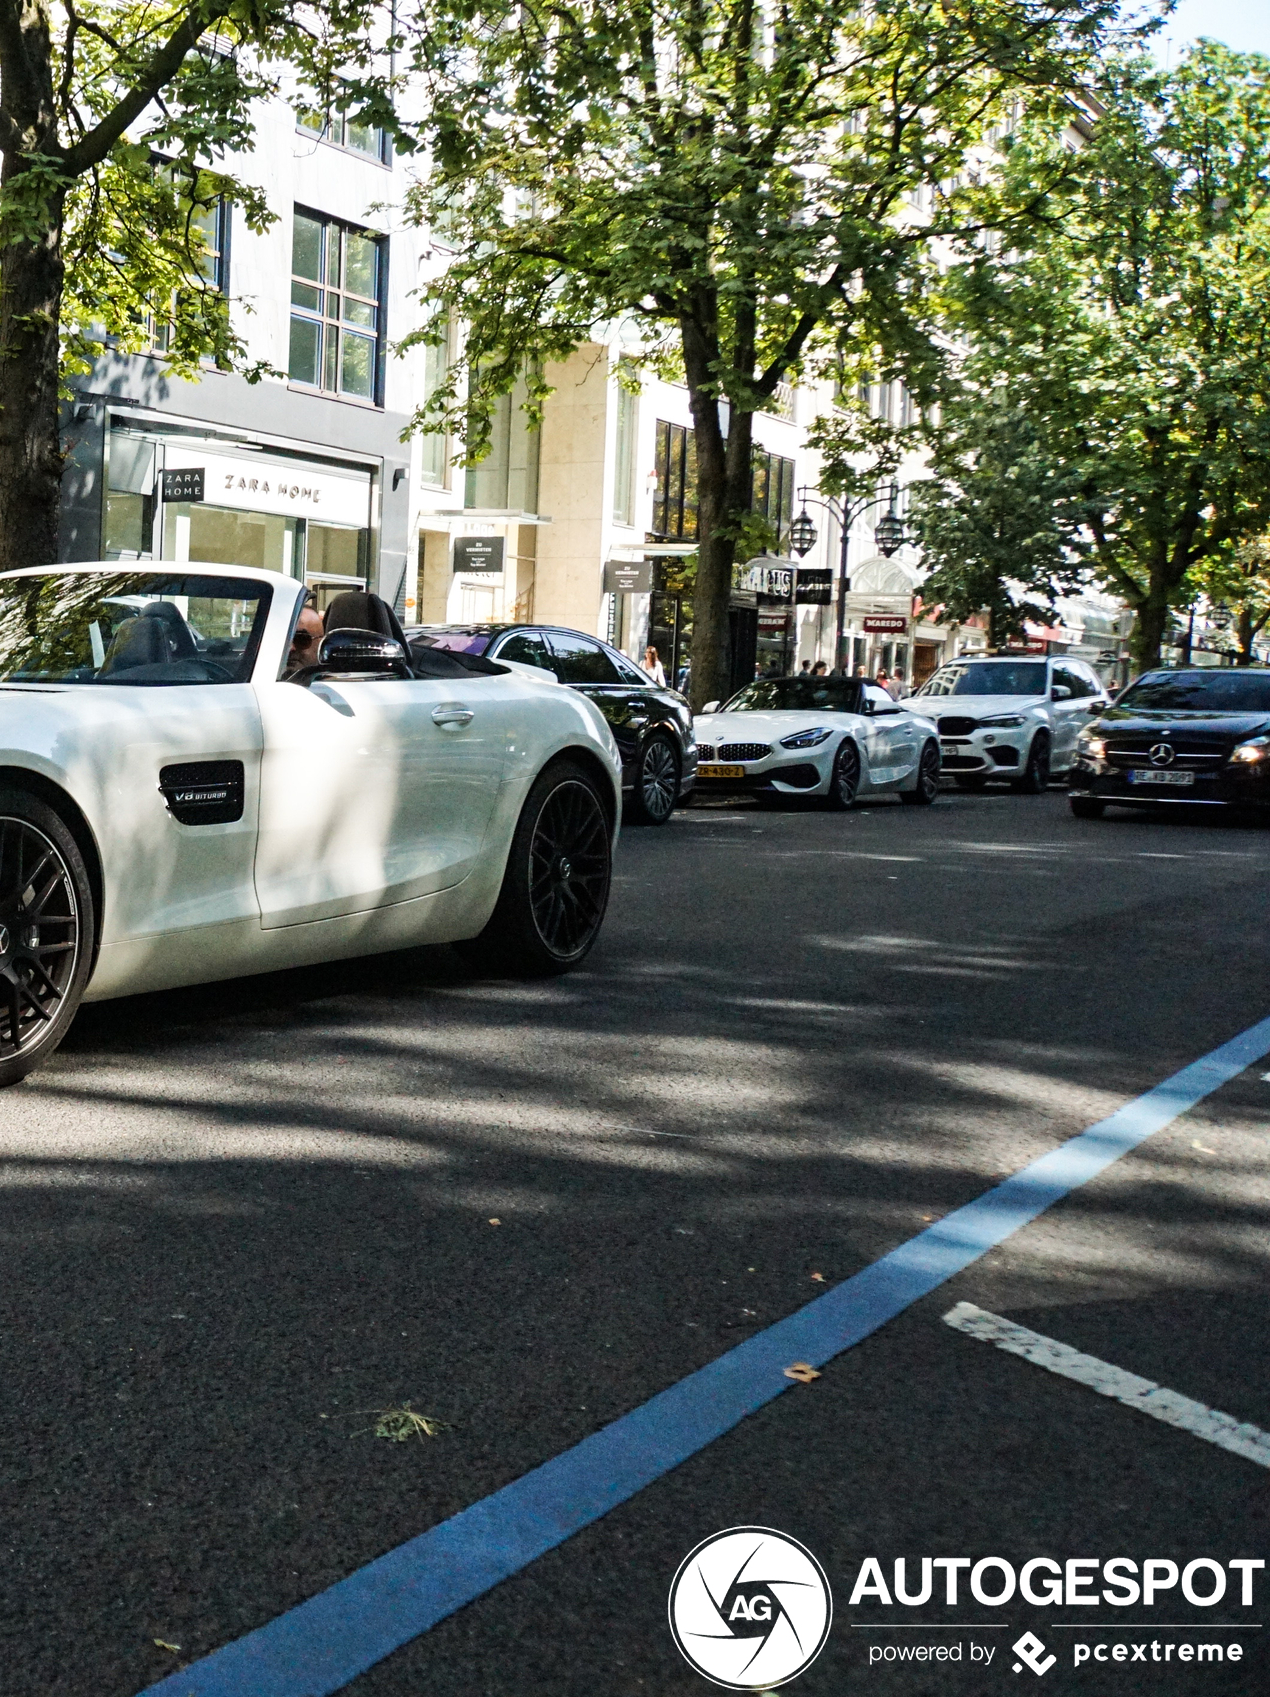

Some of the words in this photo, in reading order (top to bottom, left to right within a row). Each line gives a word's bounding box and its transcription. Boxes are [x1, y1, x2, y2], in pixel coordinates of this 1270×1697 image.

[166, 473, 200, 483] ZARA
[165, 487, 201, 496] HOME
[224, 474, 270, 494] ZARA
[277, 483, 322, 503] HOME
[866, 619, 903, 628] MAREDO
[174, 792, 193, 801] V8
[195, 792, 227, 800] BITURBO
